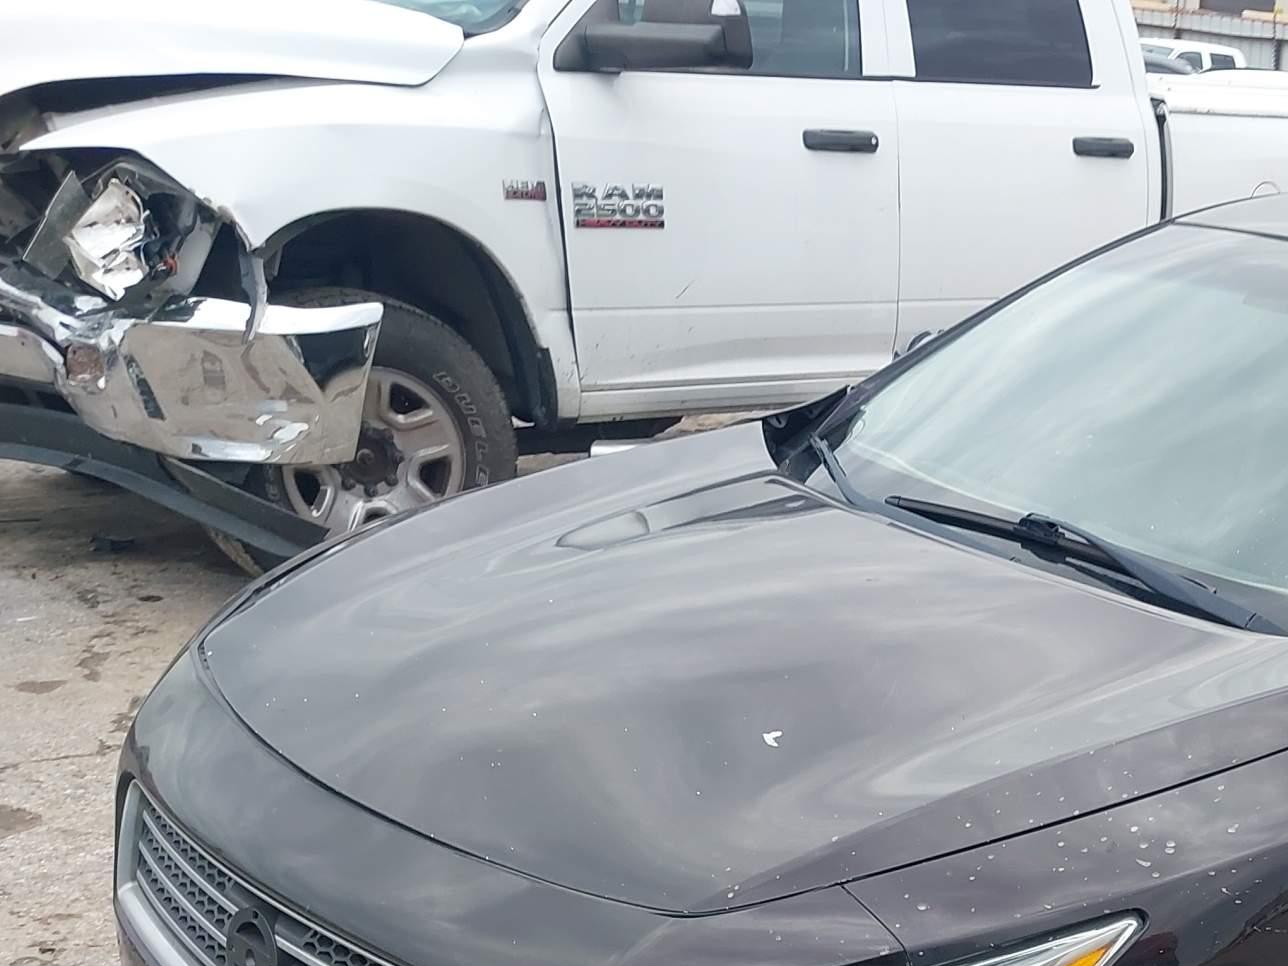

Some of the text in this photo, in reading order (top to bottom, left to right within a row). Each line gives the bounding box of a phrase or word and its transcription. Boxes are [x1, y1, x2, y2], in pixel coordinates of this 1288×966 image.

[572, 182, 664, 200] RAM
[574, 201, 665, 218] 2500
[432, 371, 489, 486] DUELE
